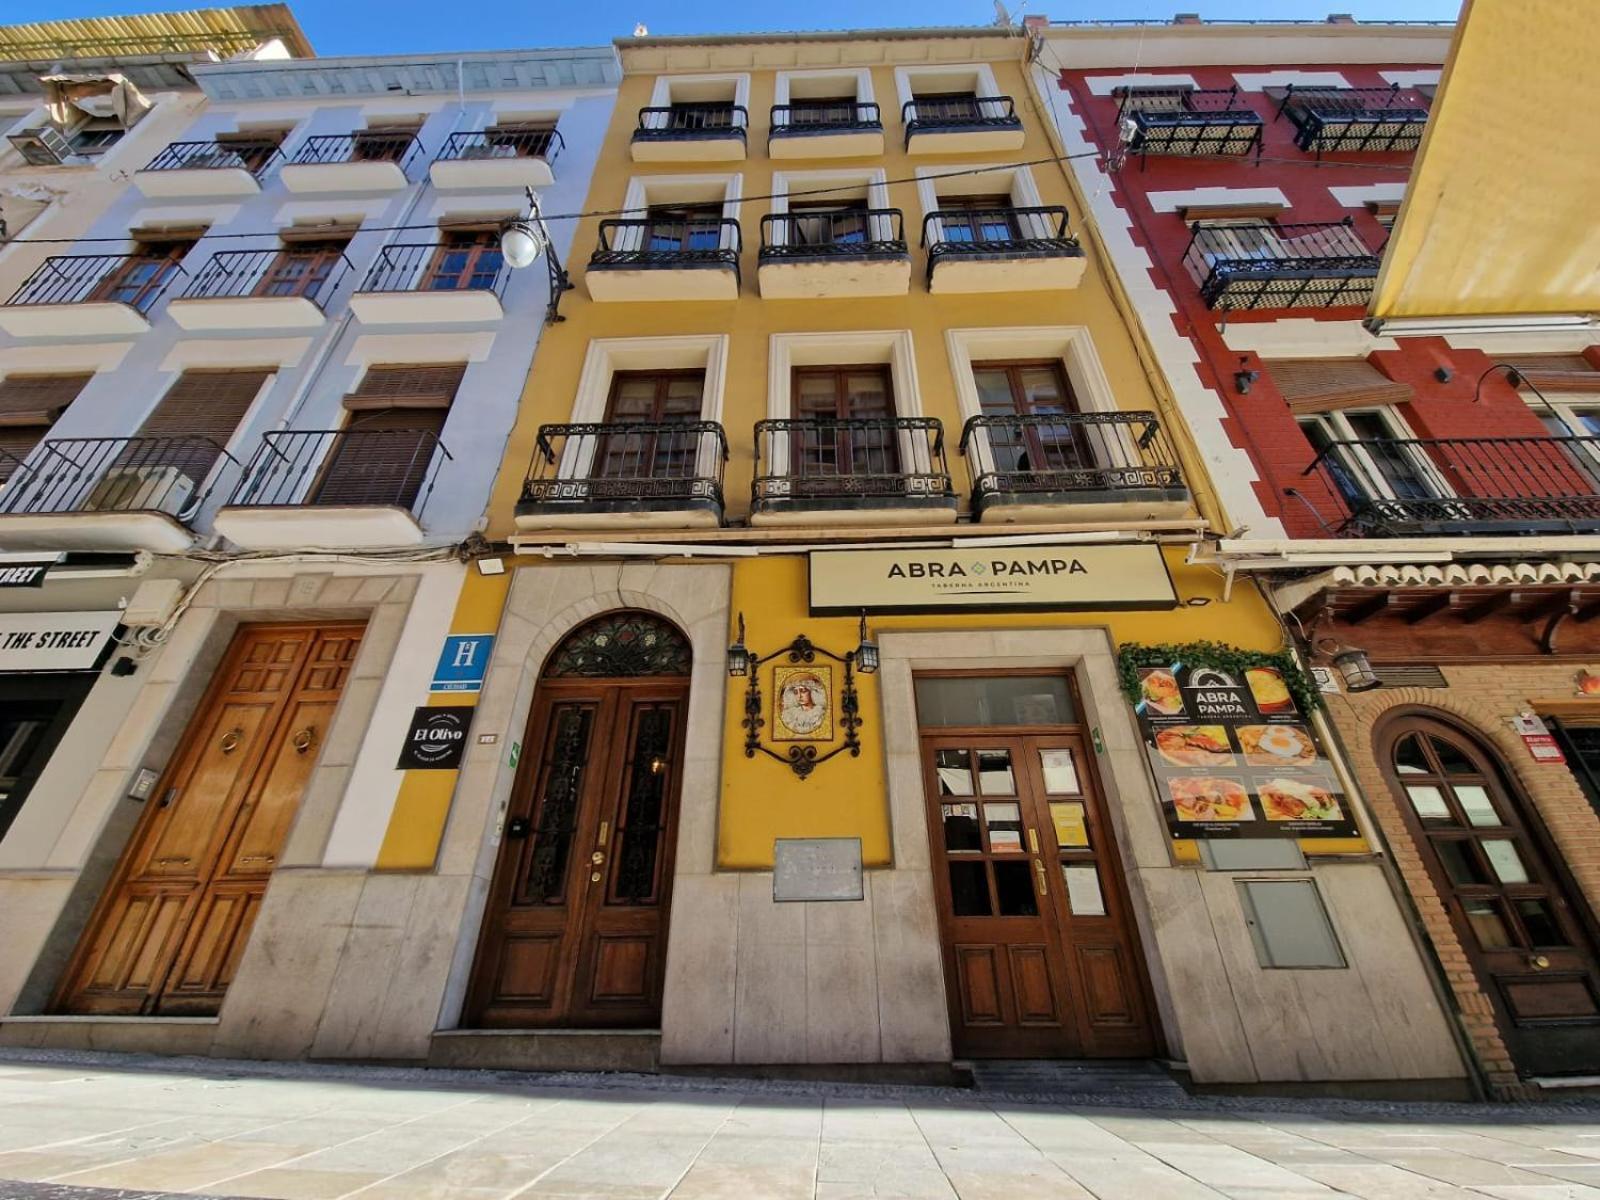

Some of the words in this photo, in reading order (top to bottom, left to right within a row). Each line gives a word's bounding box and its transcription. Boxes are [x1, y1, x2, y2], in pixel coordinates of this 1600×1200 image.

[0, 567, 42, 583] TREET
[887, 561, 967, 579] ABRA
[991, 559, 1088, 576] PAMPA
[2, 632, 36, 649] THE
[36, 631, 101, 648] STREET
[1196, 692, 1241, 703] ABRA
[1199, 704, 1245, 713] PAMPA
[413, 729, 428, 741] El
[429, 728, 463, 740] Olivo
